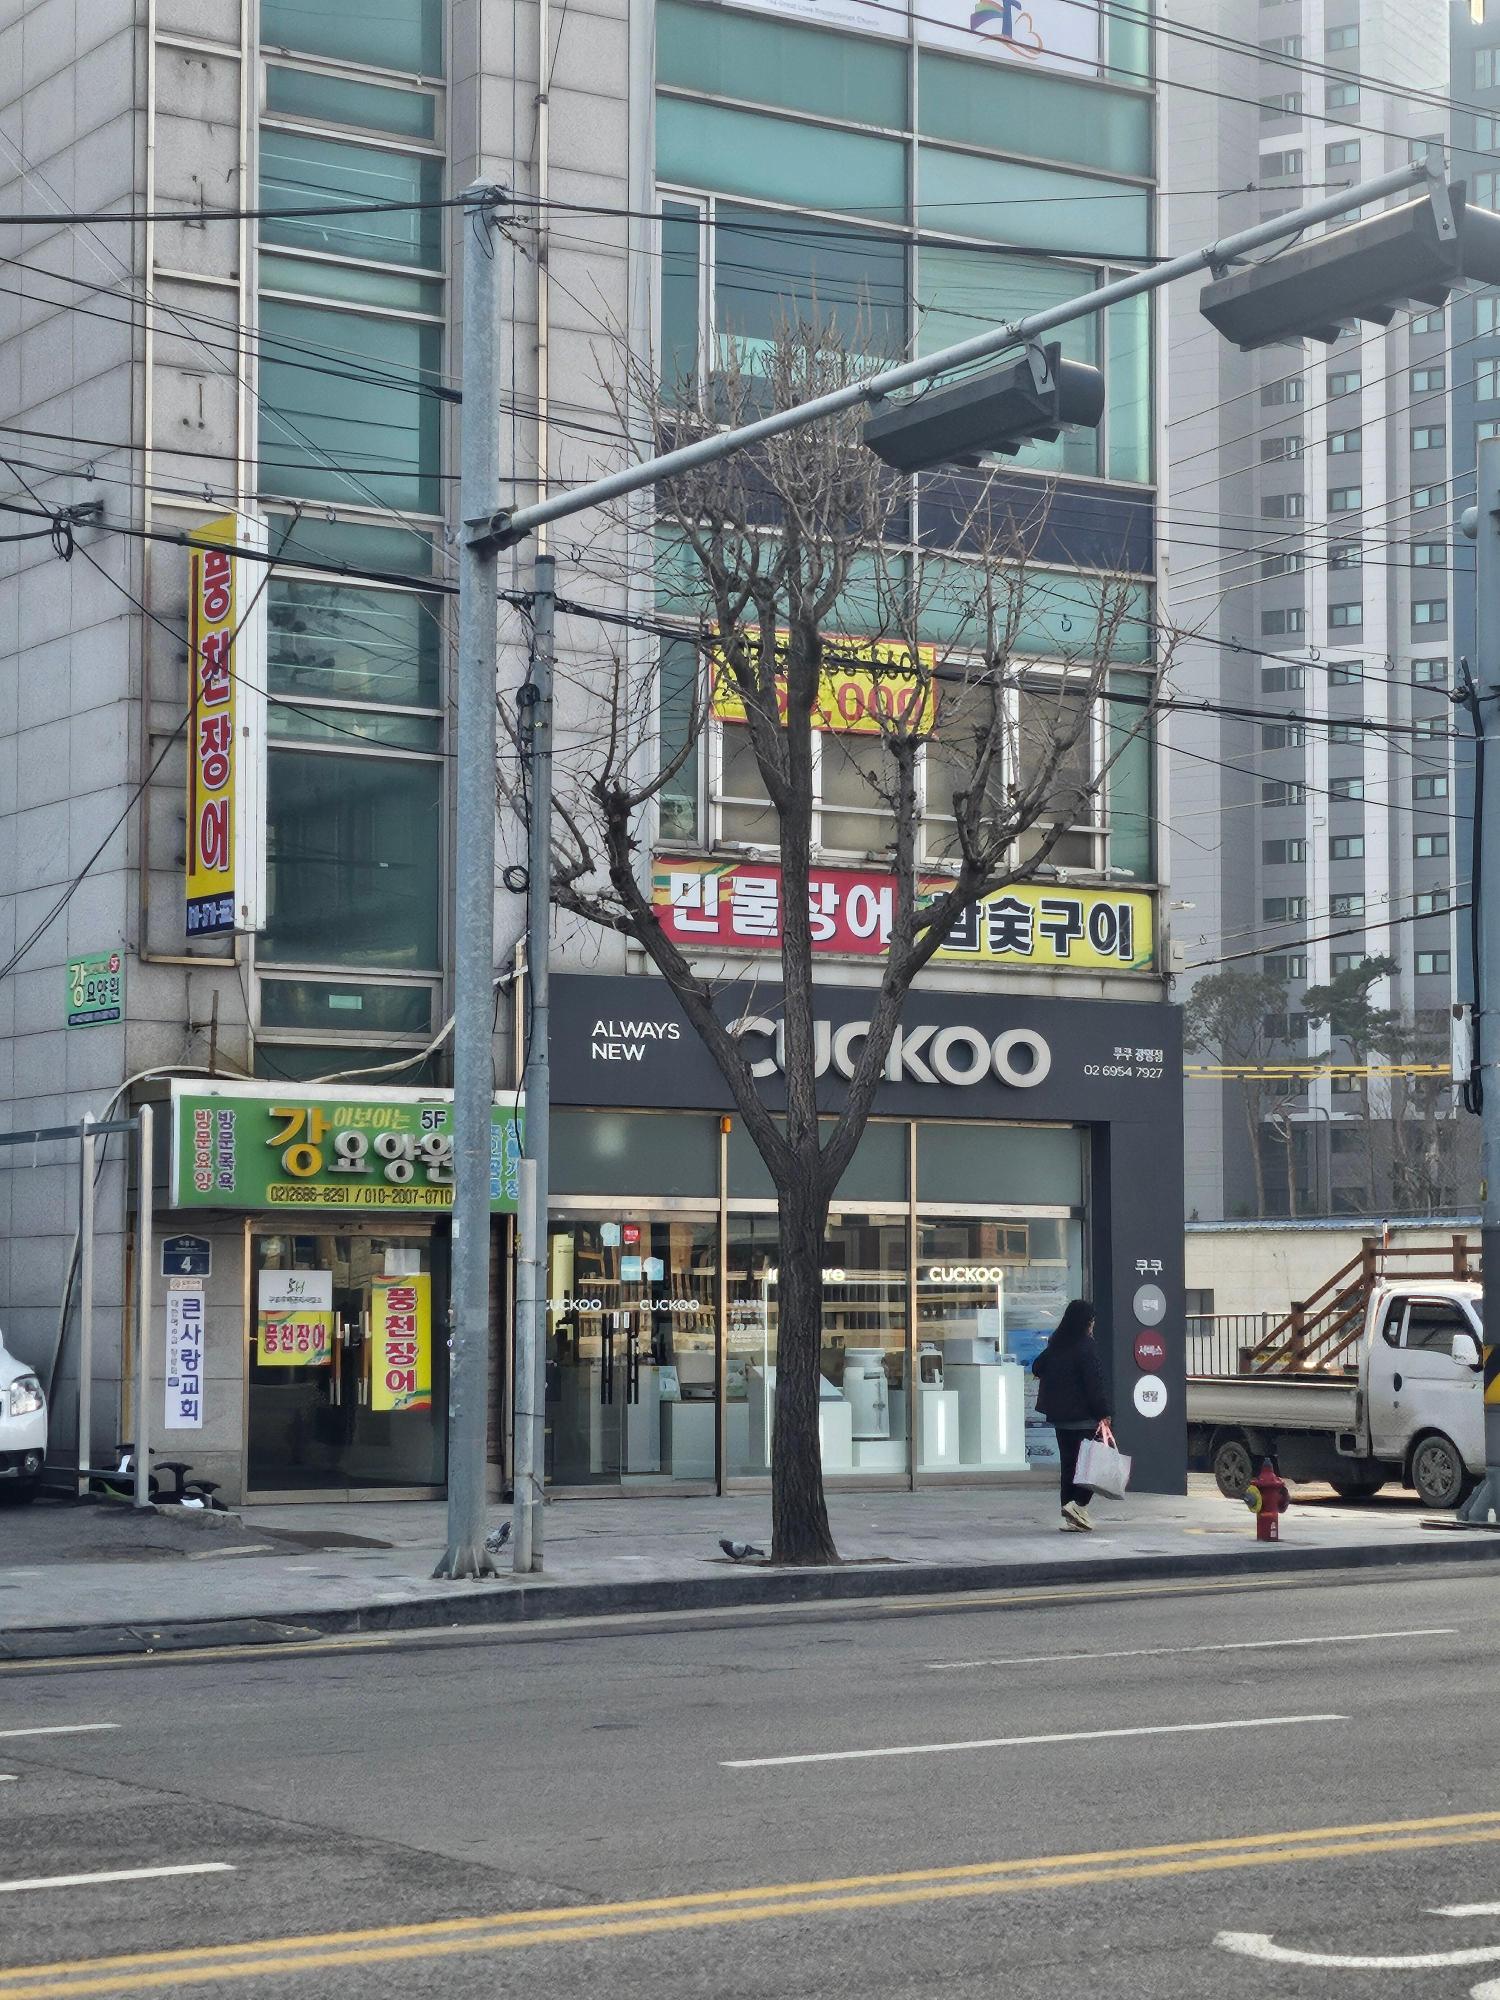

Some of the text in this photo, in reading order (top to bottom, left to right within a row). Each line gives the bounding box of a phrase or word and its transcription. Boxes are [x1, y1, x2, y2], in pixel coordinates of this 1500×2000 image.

[670, 872, 893, 944] 민물장어
[591, 1020, 681, 1040] ALWAYS
[591, 1043, 646, 1061] NEW
[1083, 1064, 1163, 1079] 02 6954 7927
[420, 1110, 448, 1131] 5F
[193, 1108, 214, 1193] 방문요양
[265, 1106, 333, 1178] 강
[328, 1130, 455, 1185] 요양원
[929, 1266, 1004, 1283] CUCKOO
[1134, 1259, 1163, 1277] 쿠쿠
[639, 1299, 700, 1311] CUCKOO
[264, 1322, 326, 1354] 풍천장어
[385, 1286, 419, 1393] 풍천장어
[180, 1297, 202, 1422] 큰사랑교회
